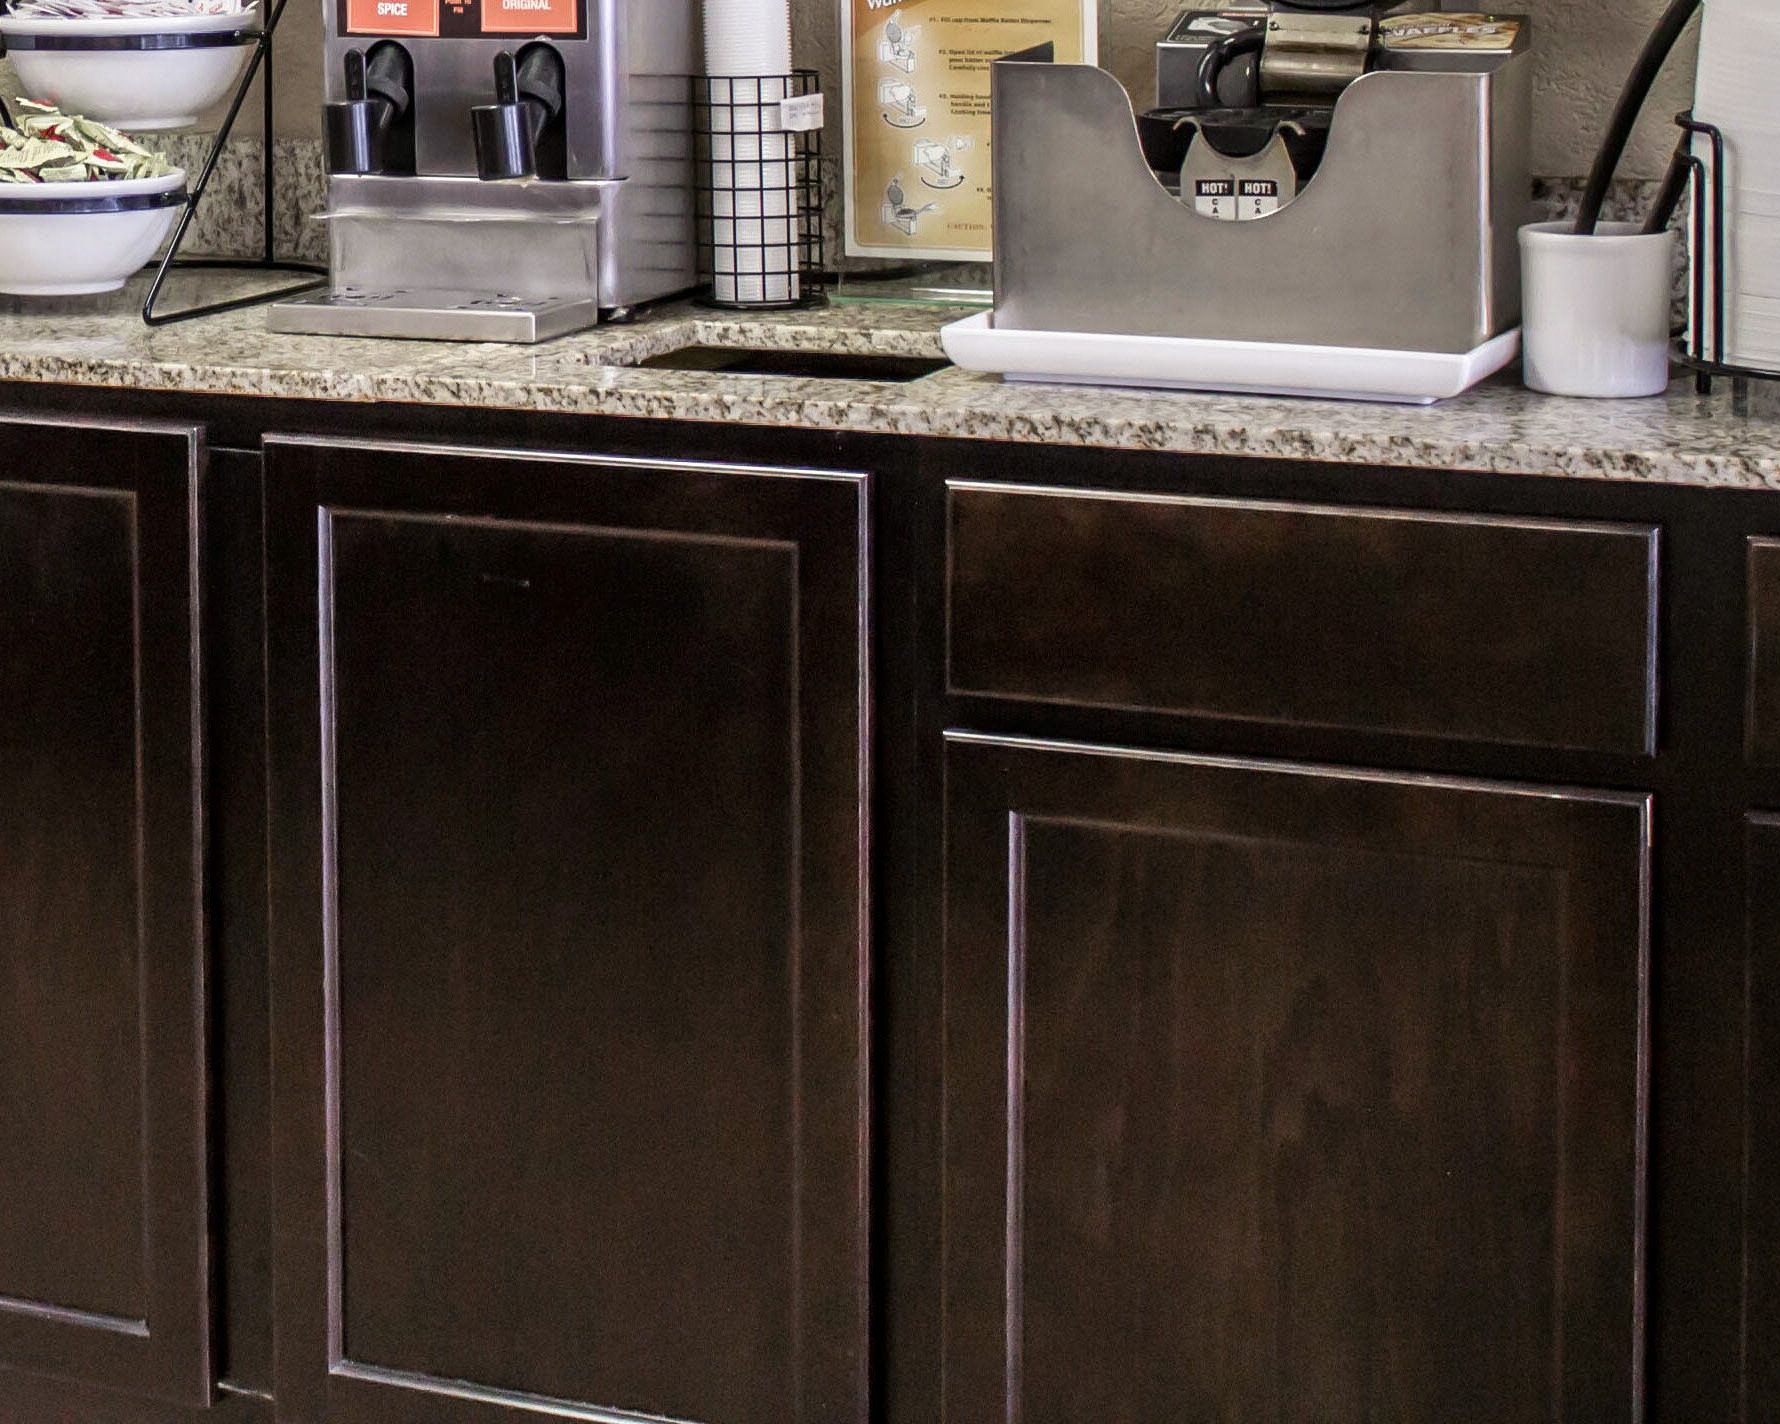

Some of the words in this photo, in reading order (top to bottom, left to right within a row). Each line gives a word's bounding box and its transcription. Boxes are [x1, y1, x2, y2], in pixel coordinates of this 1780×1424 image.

[376, 1, 408, 17] SPICE
[1201, 183, 1228, 194] HOT!
[1244, 183, 1272, 194] HOT!
